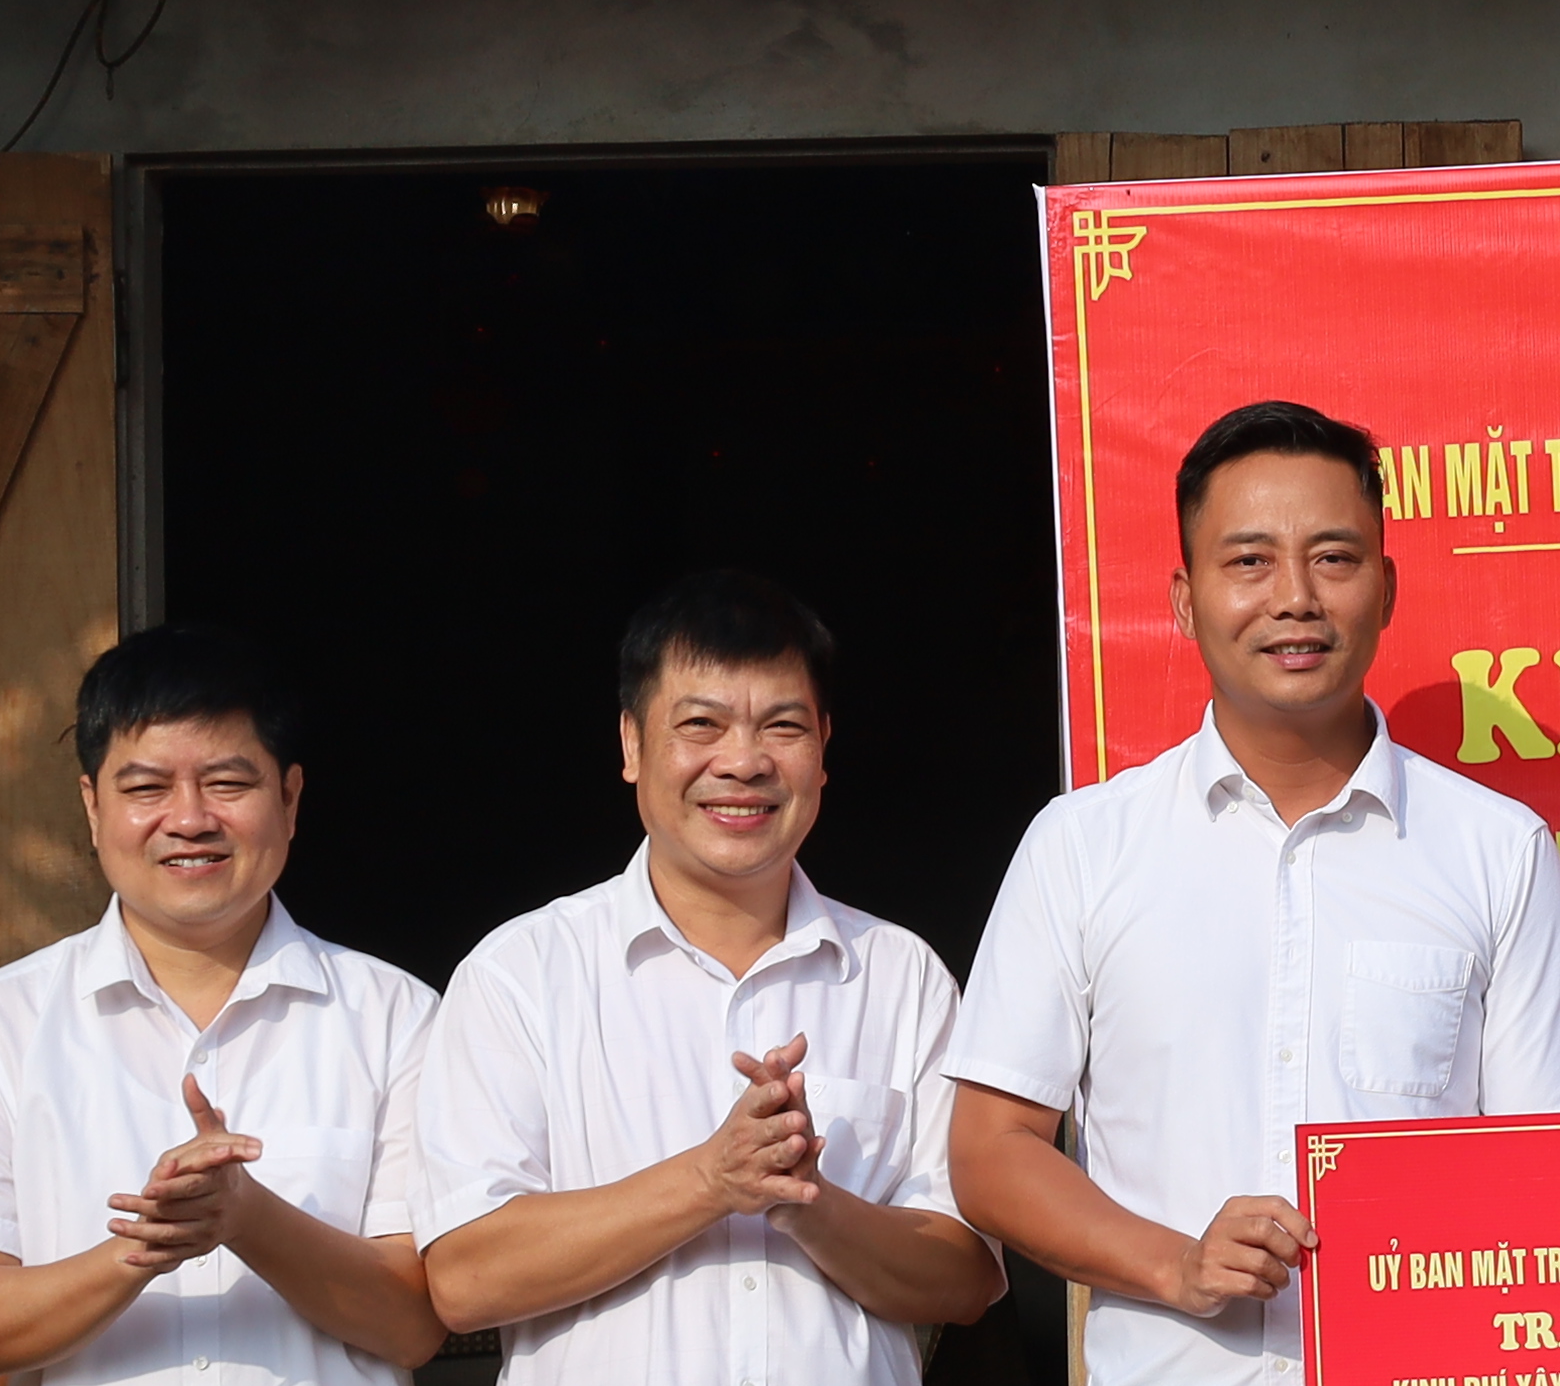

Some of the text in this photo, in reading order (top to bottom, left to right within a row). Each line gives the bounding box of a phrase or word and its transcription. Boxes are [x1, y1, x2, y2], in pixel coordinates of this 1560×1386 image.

[1378, 444, 1432, 521] AN
[1444, 424, 1533, 533] MẶT
[1368, 1238, 1402, 1292] UỶ
[1409, 1251, 1464, 1290] BAN
[1471, 1241, 1527, 1294] MẶT
